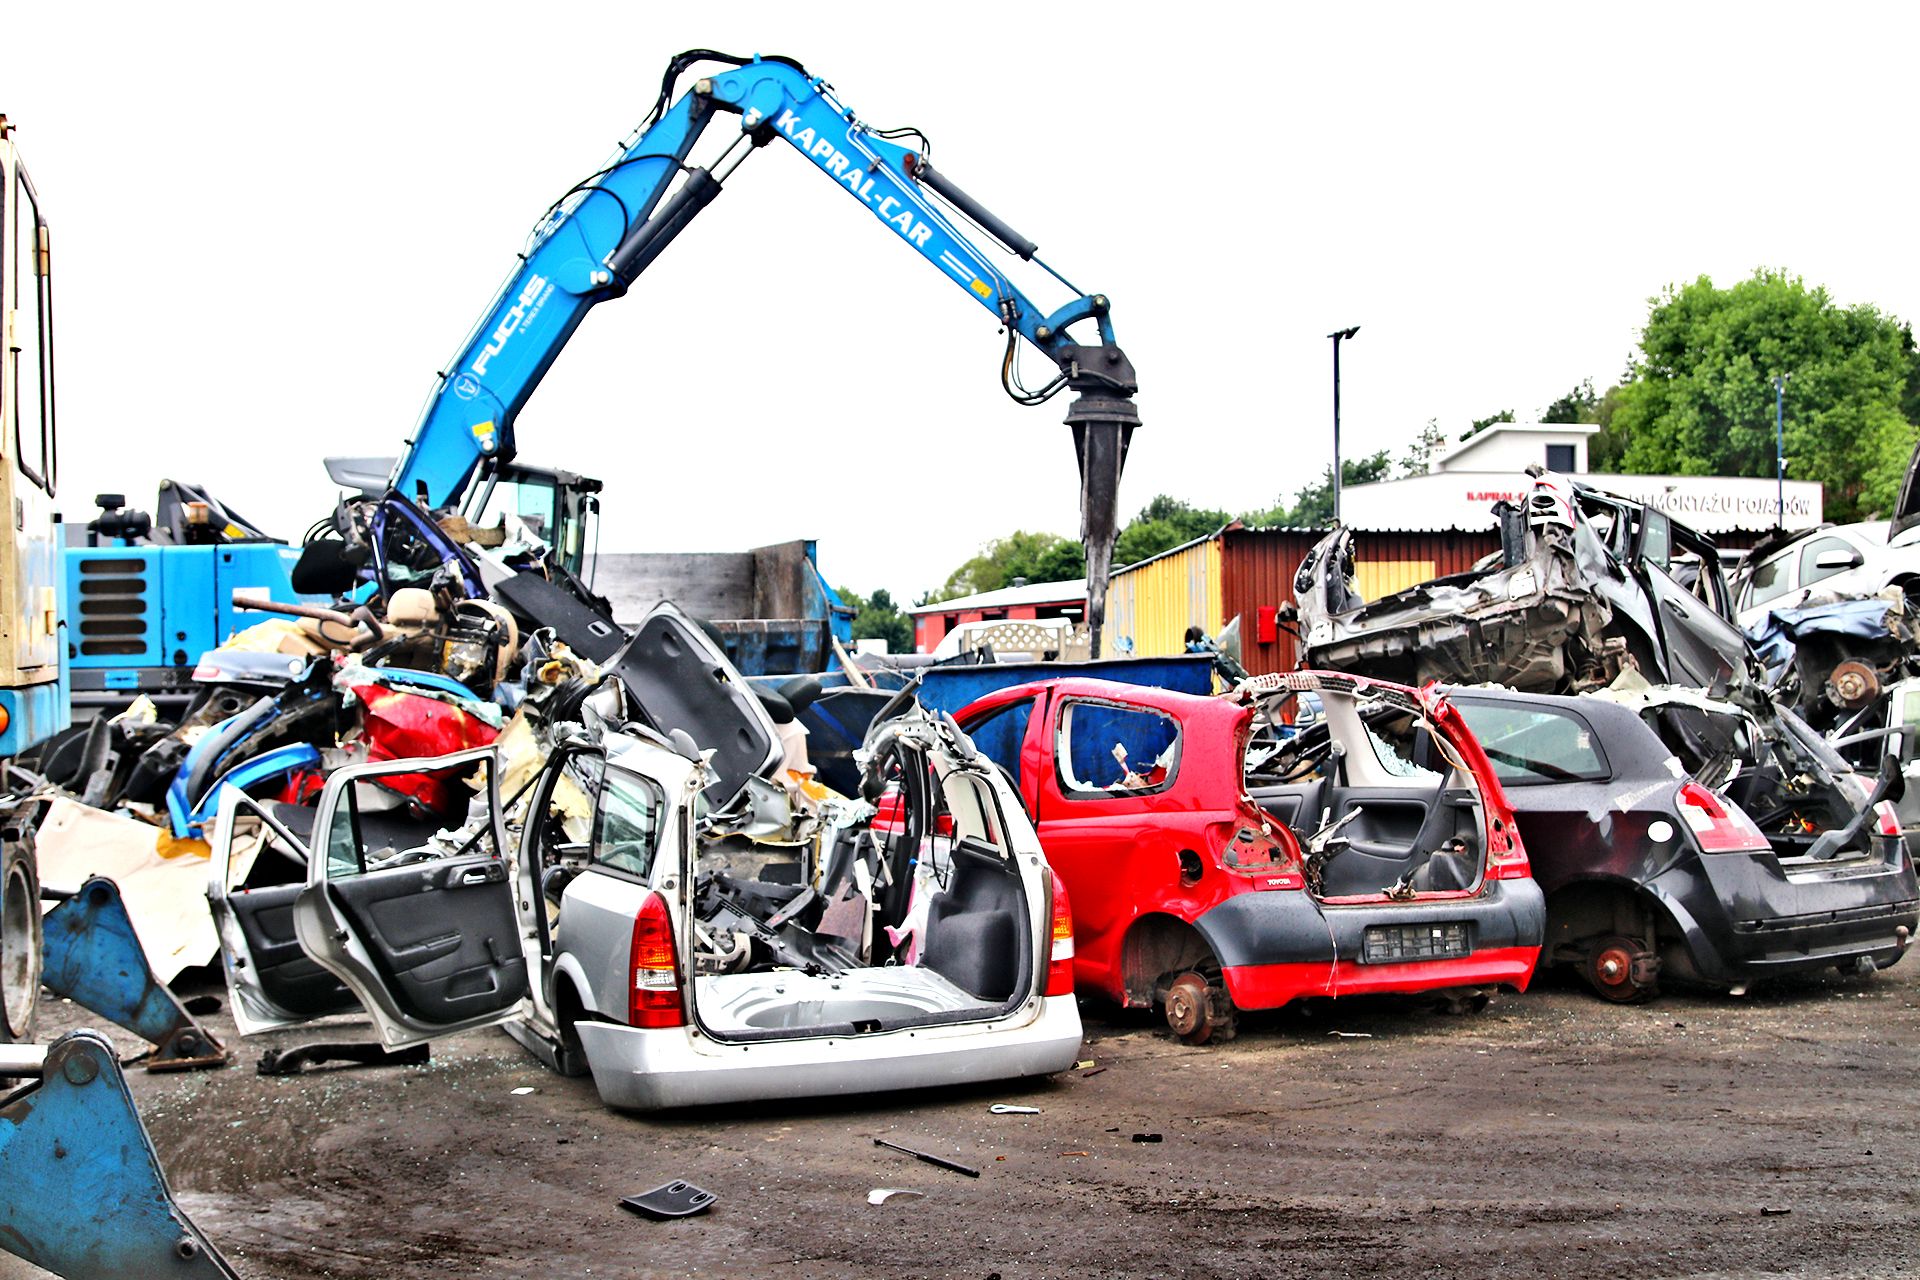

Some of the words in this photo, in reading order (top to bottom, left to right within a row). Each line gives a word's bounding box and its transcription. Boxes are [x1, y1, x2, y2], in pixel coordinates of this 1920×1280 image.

[776, 109, 932, 247] KAPRAL-CAR
[472, 274, 546, 376] FUCHS
[536, 284, 555, 307] BRAND
